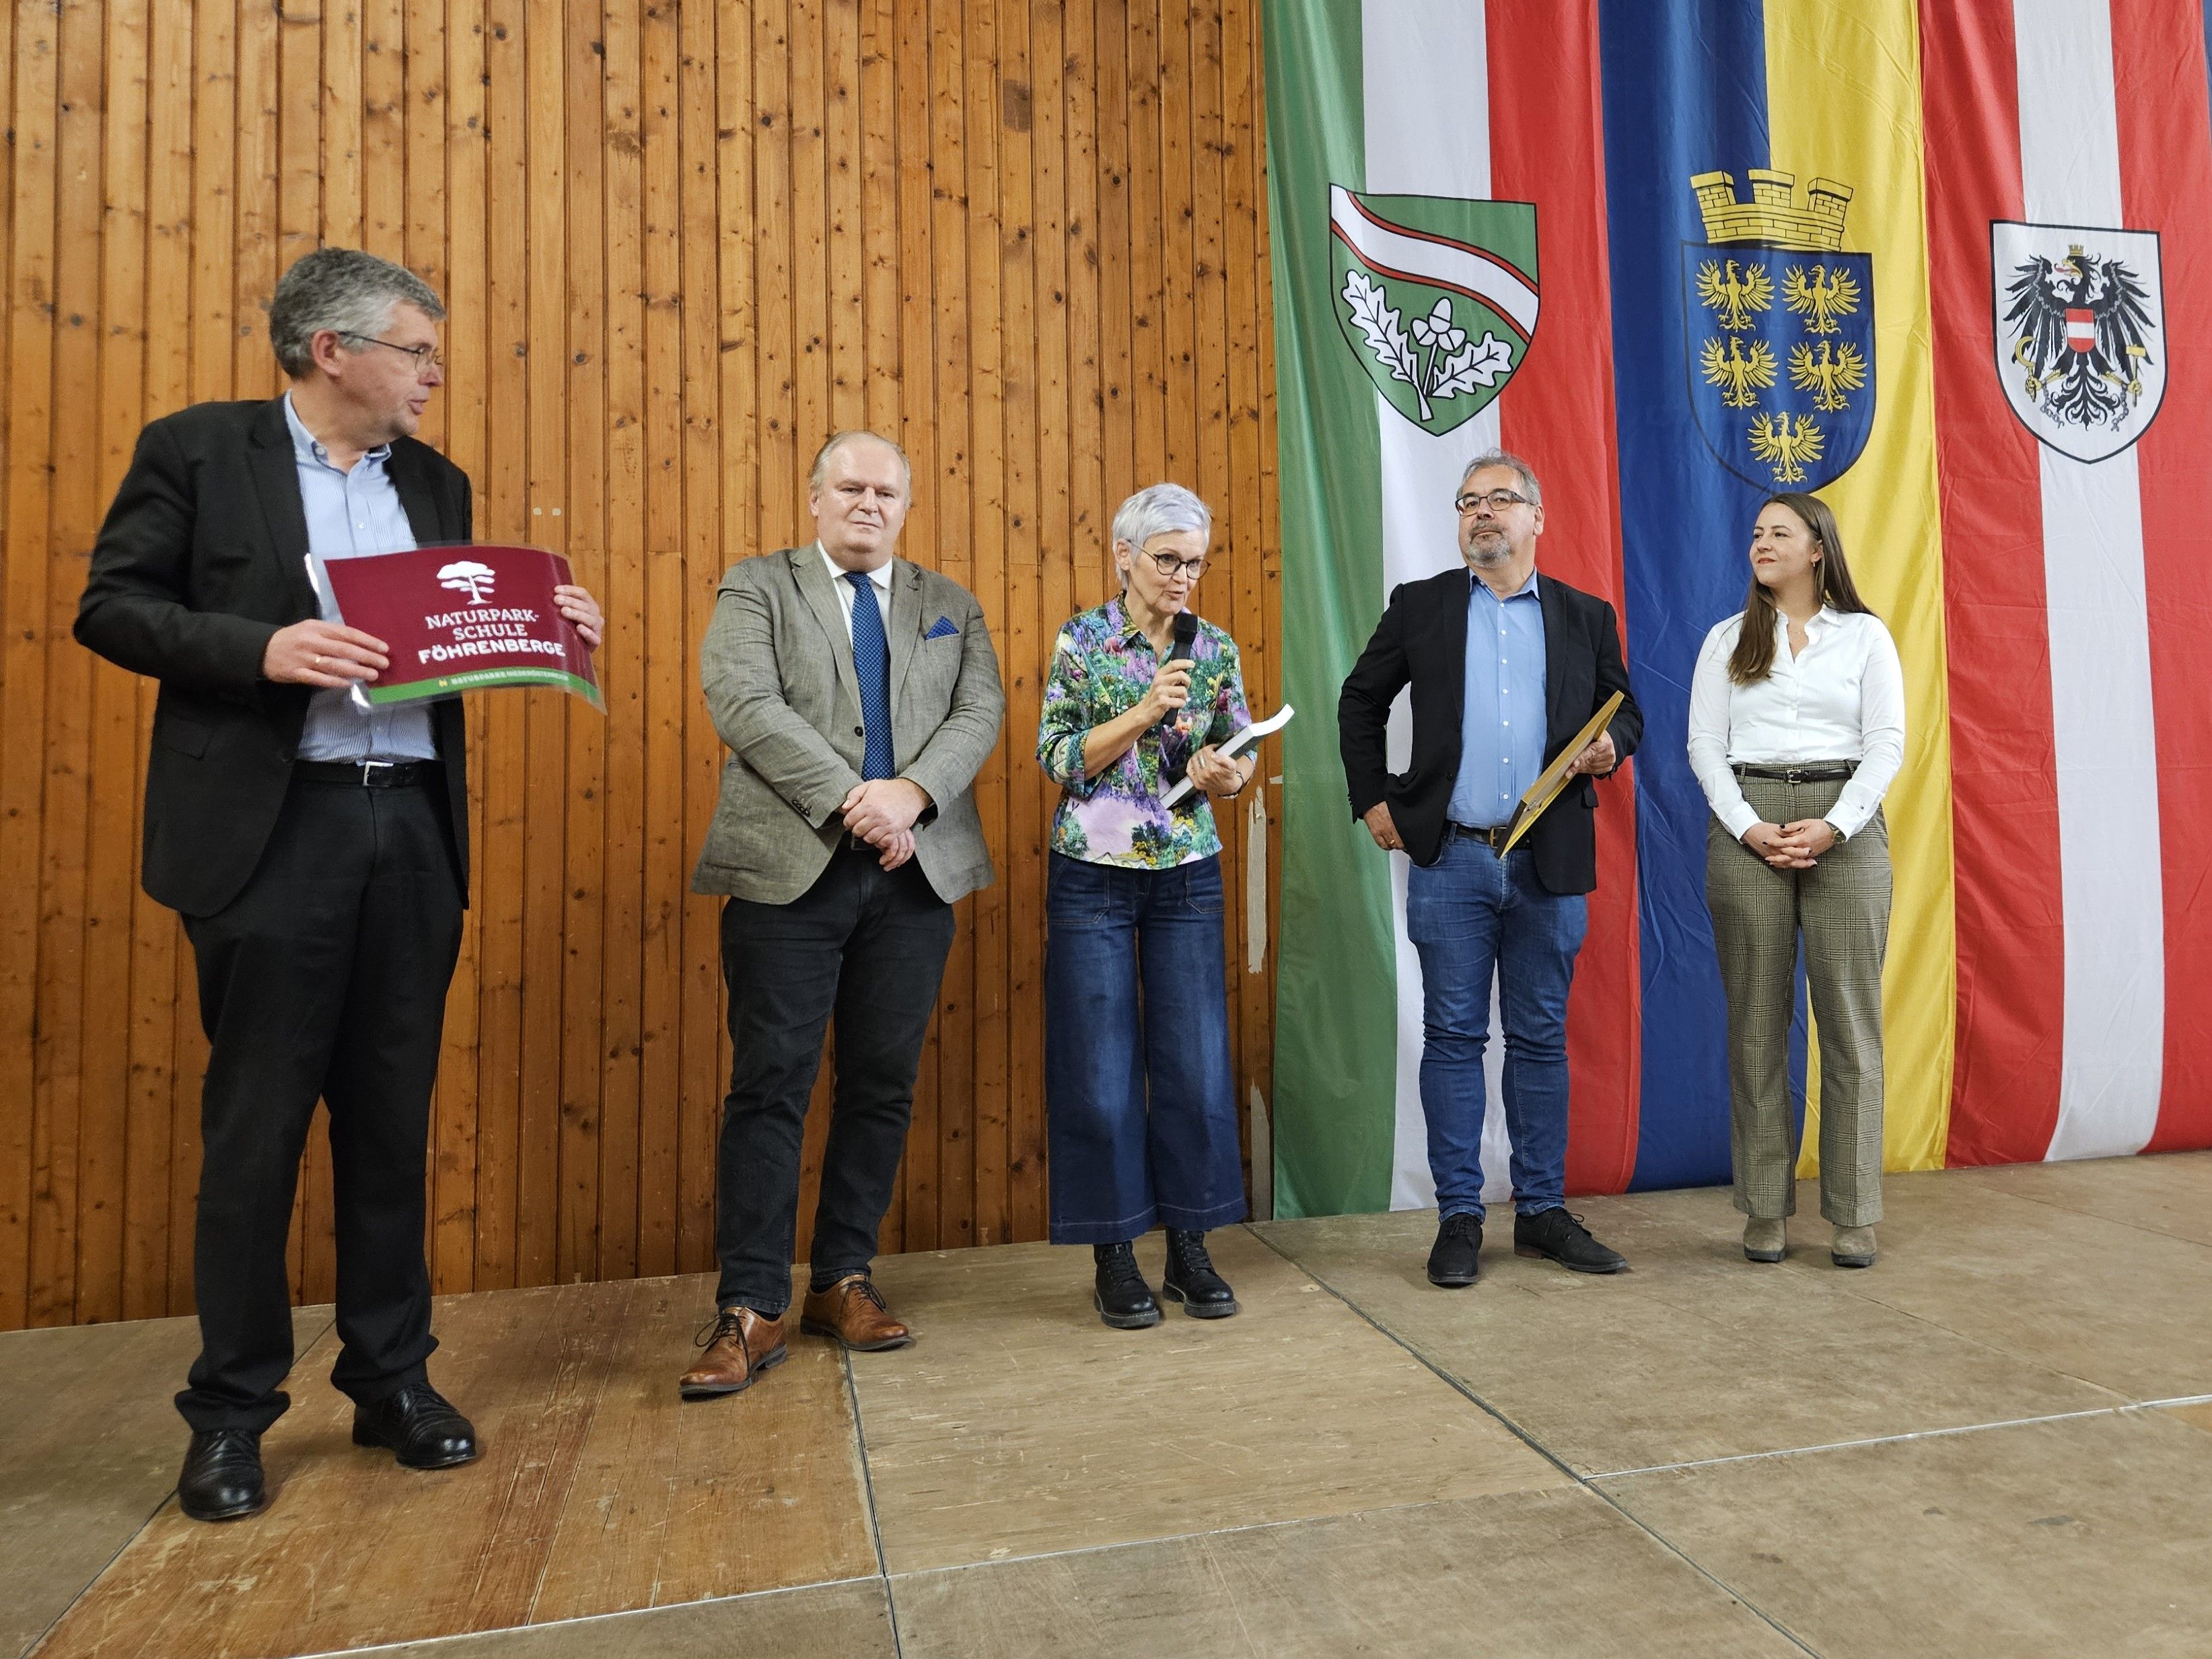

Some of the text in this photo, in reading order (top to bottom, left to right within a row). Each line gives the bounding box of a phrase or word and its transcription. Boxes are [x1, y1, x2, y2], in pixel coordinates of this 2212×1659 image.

[425, 608, 539, 629] NATURPARK-
[452, 623, 528, 641] SCHULE
[418, 639, 566, 664] FÖHRENBERGE
